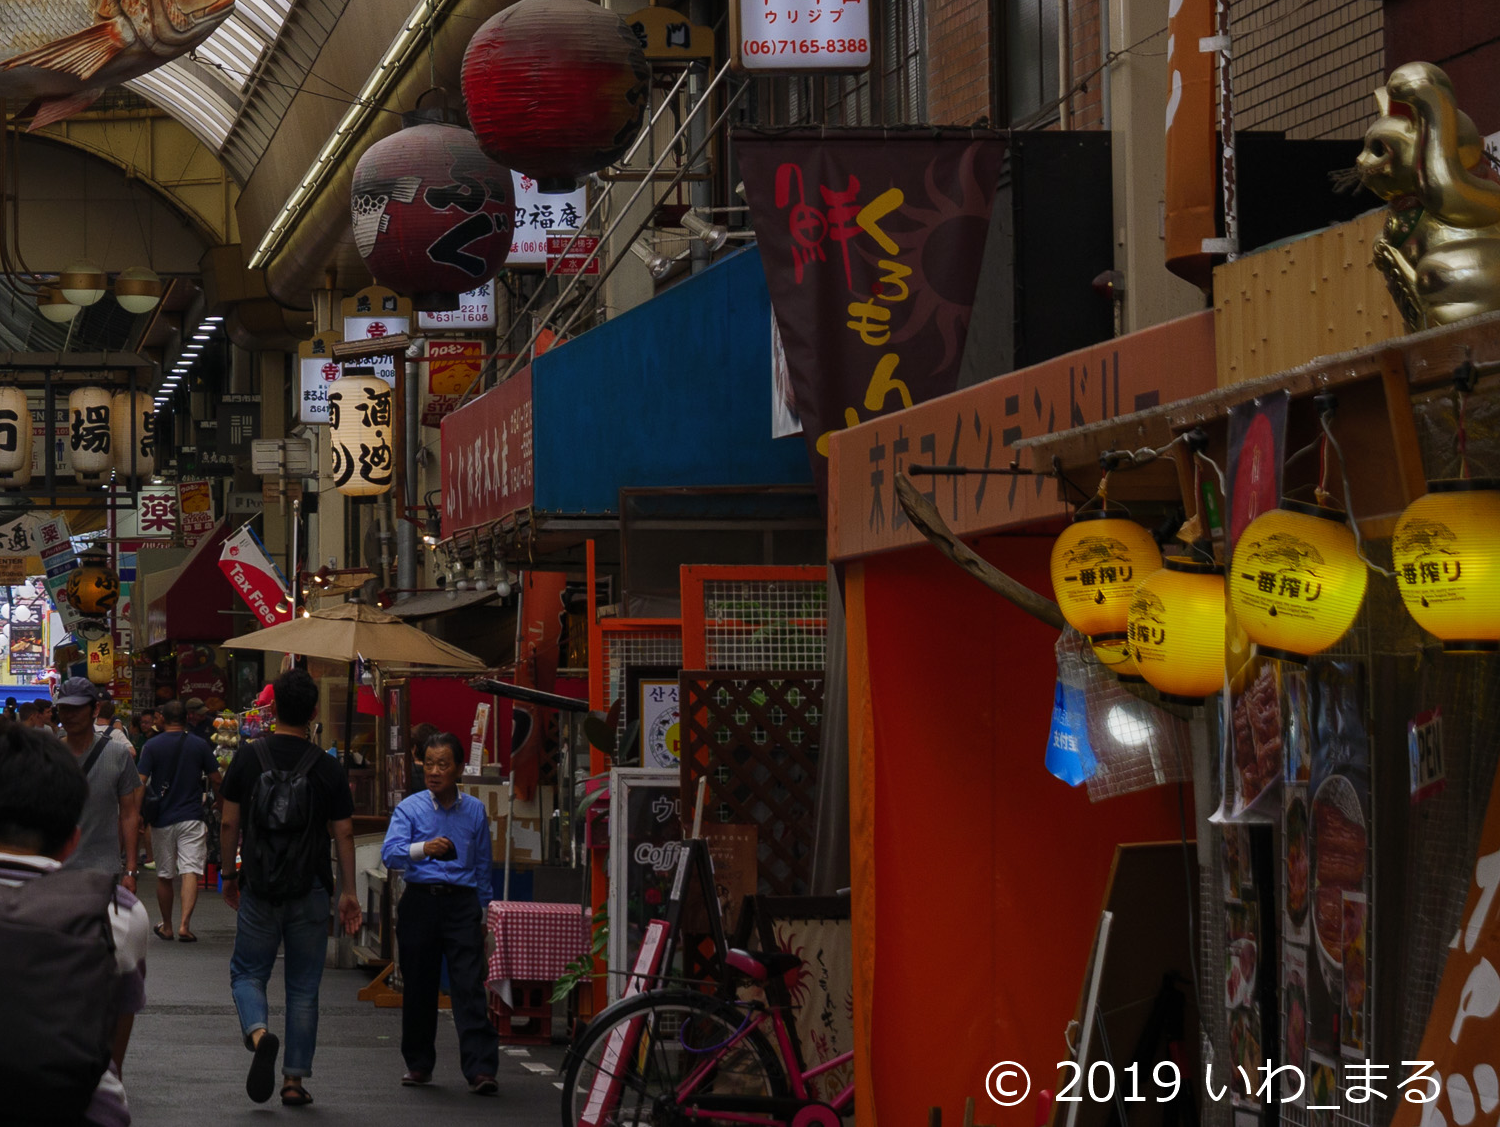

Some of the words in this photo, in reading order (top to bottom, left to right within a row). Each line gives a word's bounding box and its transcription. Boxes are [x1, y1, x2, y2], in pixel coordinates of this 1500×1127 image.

[765, 8, 844, 24] ウリジプ
[744, 39, 868, 56] (06)7165-8388
[357, 296, 398, 312] 黒門
[431, 345, 465, 355] クロモン
[142, 495, 176, 531] 薬
[183, 516, 211, 524] STAMP
[1064, 566, 1133, 585] 一番搾り
[229, 562, 252, 594] Tax
[248, 589, 276, 625] Free
[1241, 570, 1322, 602] 一番搾り
